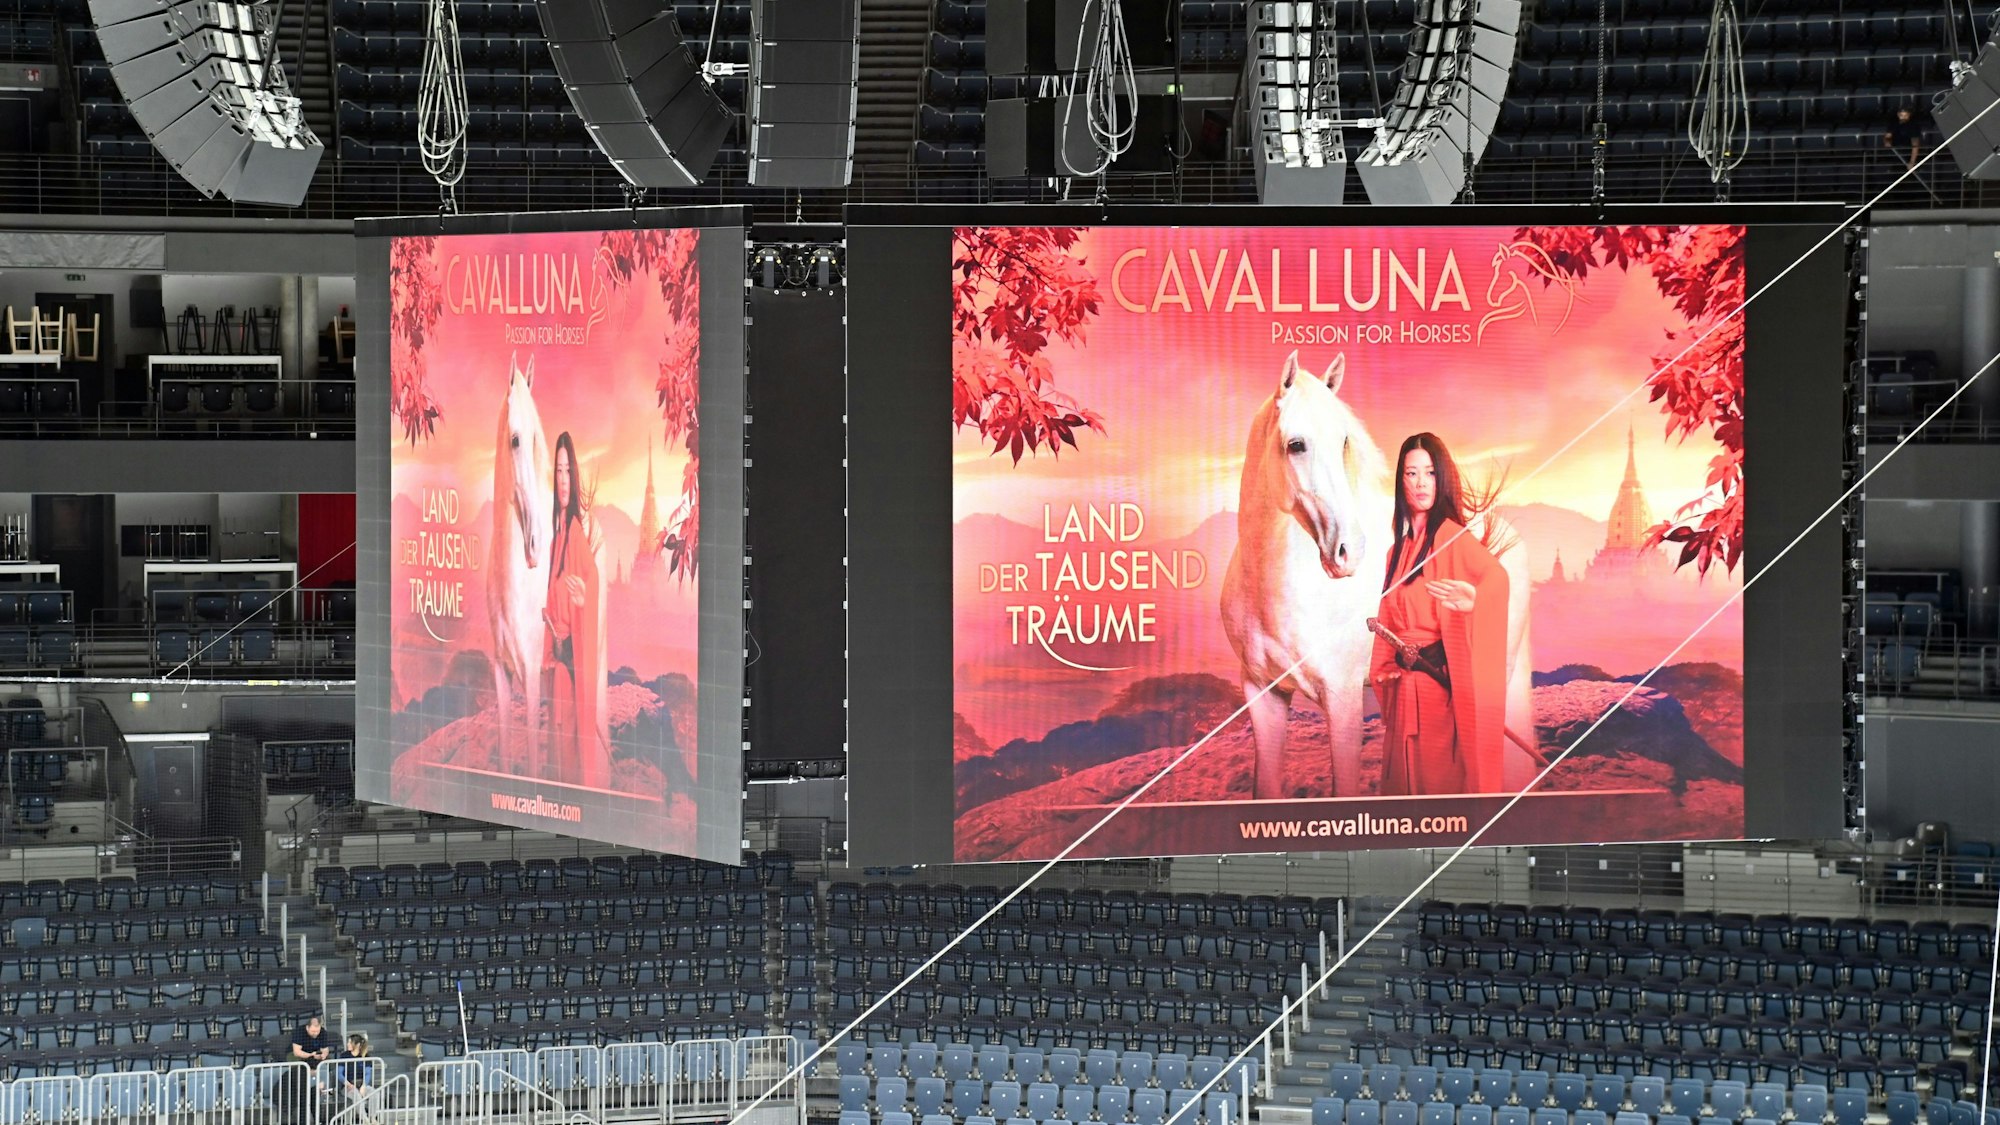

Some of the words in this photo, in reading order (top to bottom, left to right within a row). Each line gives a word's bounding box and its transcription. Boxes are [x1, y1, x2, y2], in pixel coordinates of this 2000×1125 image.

[446, 252, 585, 315] CAVALLUNA
[1110, 247, 1472, 313] CAVALLUNA
[1271, 321, 1350, 345] PASSION
[1356, 325, 1393, 345] FOR
[1399, 321, 1472, 344] HORSES
[422, 487, 459, 524] LAND
[1043, 502, 1145, 543] LAND
[400, 539, 418, 566] DER
[419, 531, 481, 570] TAUSEND
[979, 563, 1029, 593] DER
[1035, 550, 1207, 592] TAUSEND
[409, 570, 463, 642] TRÄUME
[1005, 594, 1156, 671] TRÄUME
[491, 793, 581, 822] www.cavalluna.com
[1239, 813, 1468, 839] www.cavalluna.com
